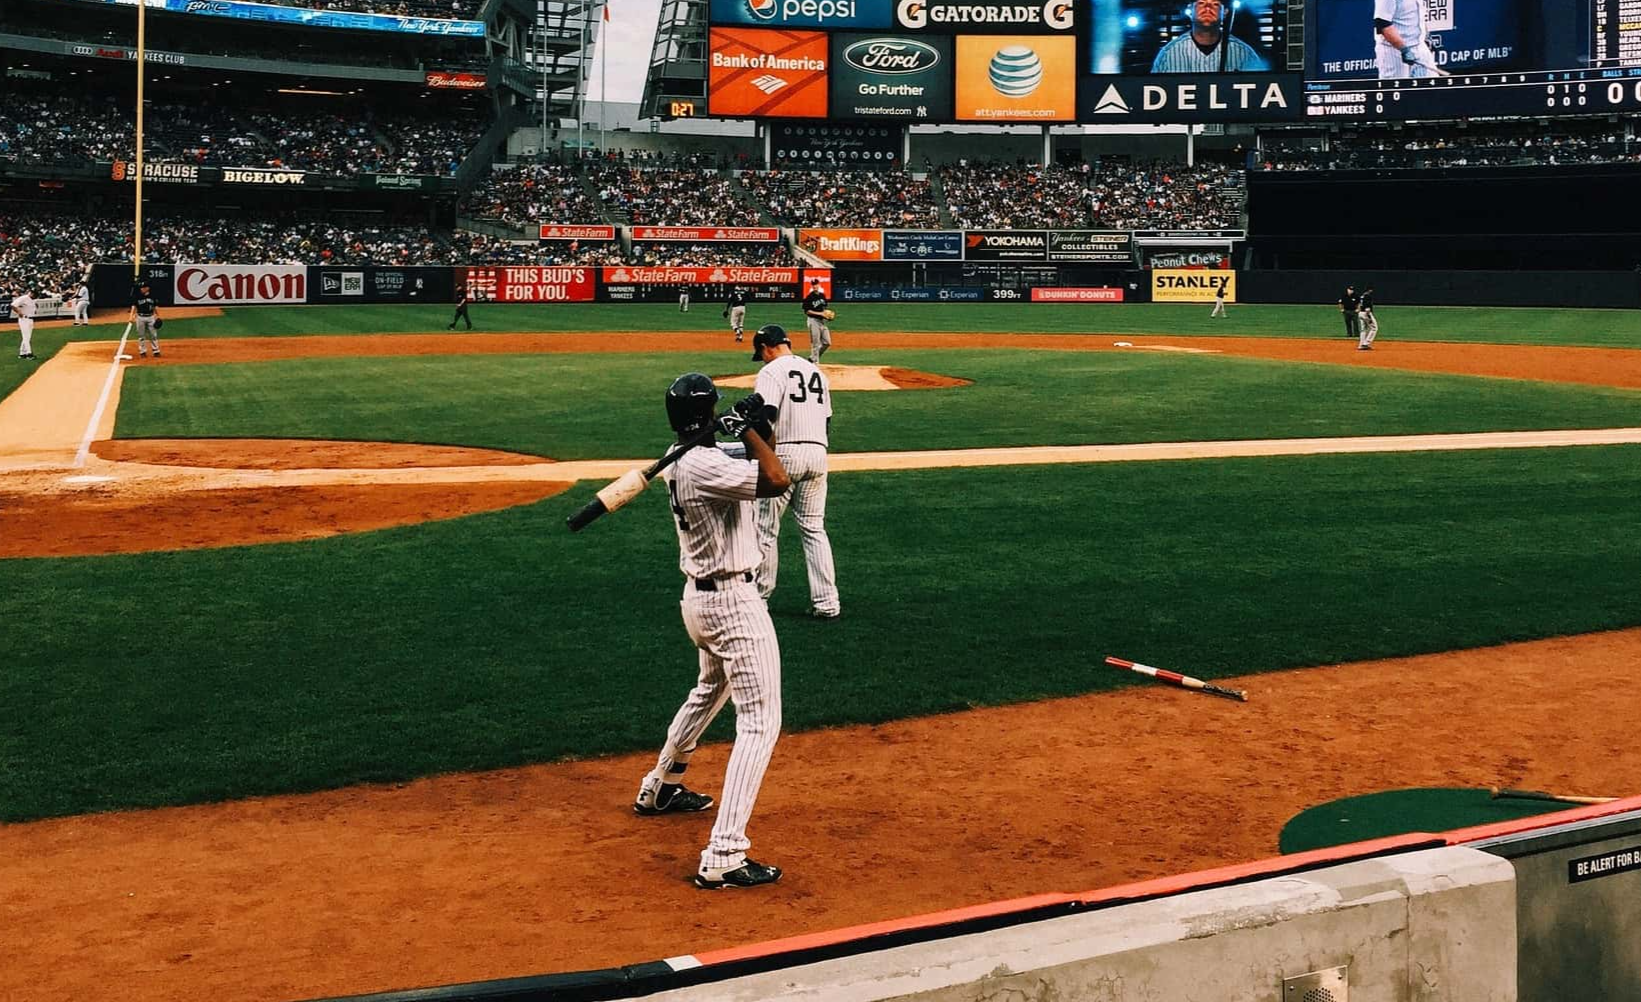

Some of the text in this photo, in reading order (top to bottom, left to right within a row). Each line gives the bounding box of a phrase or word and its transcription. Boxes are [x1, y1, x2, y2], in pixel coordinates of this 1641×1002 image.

[783, 0, 855, 21] pepsi
[931, 7, 1040, 22] GATORADE
[128, 51, 163, 62] YAKEES
[165, 54, 184, 64] CLUB
[713, 53, 825, 70] Bank of America
[863, 43, 921, 68] Ford
[1324, 62, 1341, 73] THE
[1451, 51, 1470, 62] CAP
[1473, 49, 1485, 60] OF
[427, 76, 486, 88] Budweiser
[859, 84, 924, 96] Go Further
[1143, 83, 1288, 110] DELTA
[1324, 83, 1624, 104] MARINERS 0 0 0 1 0 0
[1325, 96, 1586, 115] YANKEES 0 0 0 0
[127, 163, 199, 178] SRACUSE
[820, 237, 880, 252] DraftKings
[984, 237, 1044, 246] YOKOHAMA
[1151, 252, 1223, 268] Peanut Chews
[505, 269, 585, 283] THIS BUD'S
[1156, 276, 1230, 288] STANLEY
[177, 268, 305, 301] Canon
[505, 285, 570, 300] FOR YOU.
[788, 369, 824, 405] 34
[1577, 862, 1589, 876] BE
[1590, 856, 1616, 874] ALERT
[1617, 853, 1633, 867] FOR
